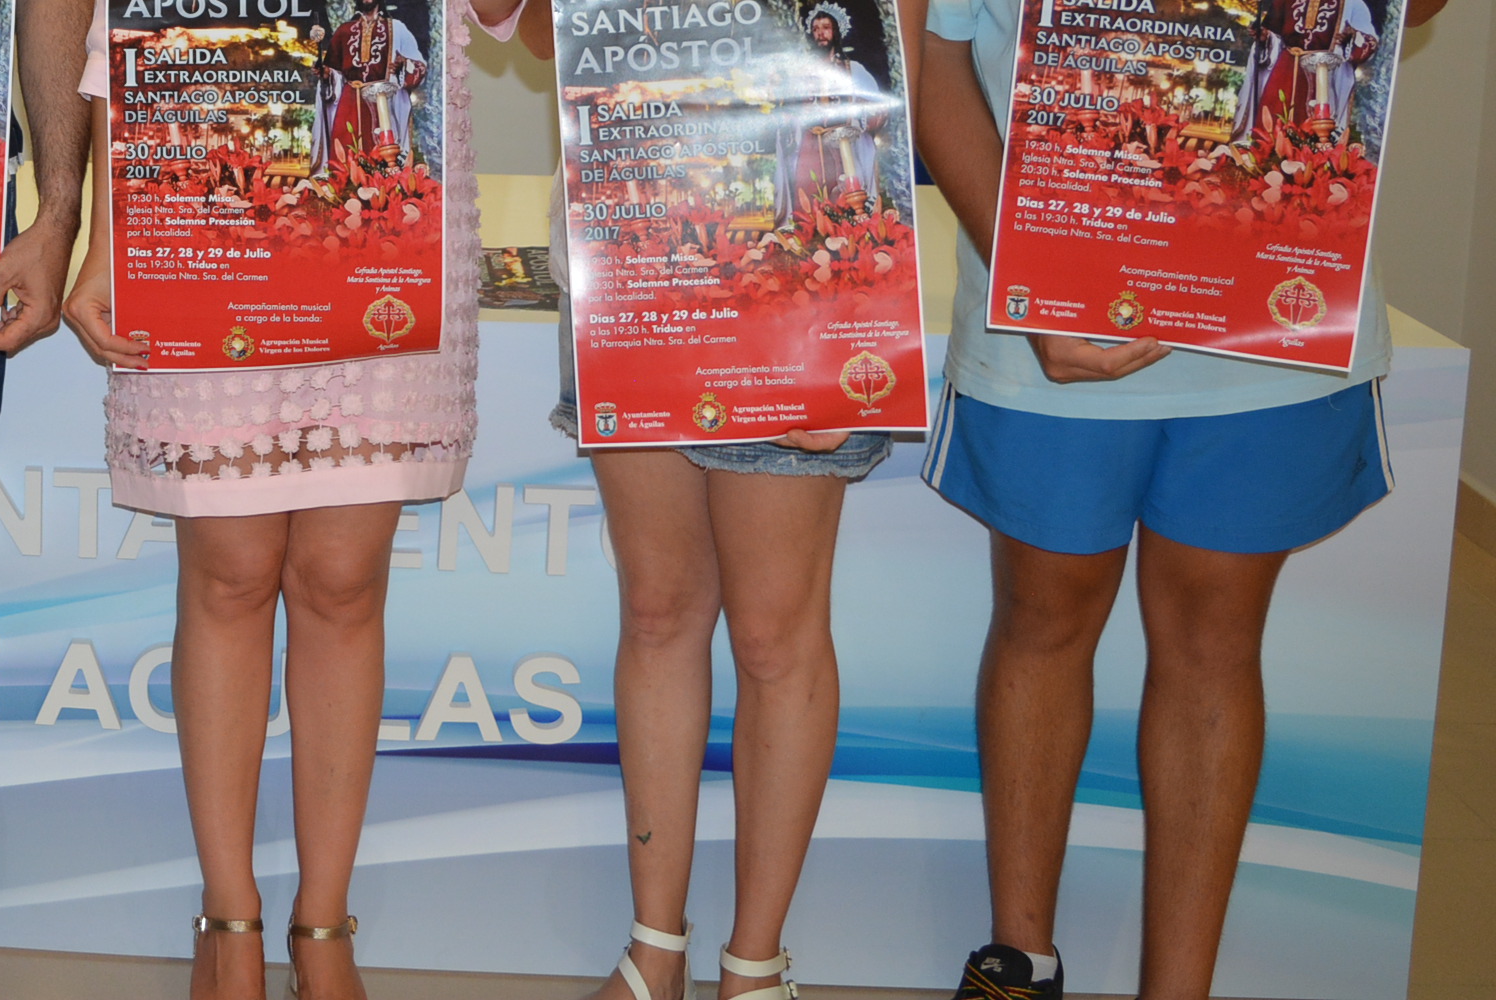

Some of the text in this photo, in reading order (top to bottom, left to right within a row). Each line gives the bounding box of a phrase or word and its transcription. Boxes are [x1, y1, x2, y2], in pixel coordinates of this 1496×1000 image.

[570, 0, 762, 36] SANTIAGO
[1060, 11, 1235, 42] EXTRAORDINARIA
[1036, 31, 1235, 64] SANTIAGO APÓSTOL
[144, 49, 227, 65] SALIDA
[1033, 51, 1147, 76] DE ÁGUILAS
[144, 70, 302, 83] EXTRAORDINARIA
[125, 87, 305, 103] SANTIAGO APÓSTOL
[1030, 87, 1119, 112] 30 JULIO
[125, 107, 227, 123] DE ÁGUILAS
[597, 101, 683, 122] SALIDA
[1026, 110, 1066, 127] 2017
[126, 144, 206, 159] 30 JULIO
[580, 138, 765, 163] SANTIAGO APÓSTOL
[126, 166, 160, 178] 2017
[581, 164, 686, 183] DE ÁGUILAS
[1019, 178, 1092, 192] por la localidad.
[127, 194, 234, 202] 19:30 h. Solemne Misa.
[584, 203, 666, 221] 30 JULIO
[1048, 200, 1069, 213] 27,
[1072, 203, 1090, 215] 28
[1093, 208, 1102, 217] y
[1105, 207, 1123, 218] 29
[1125, 208, 1142, 220] de
[1145, 210, 1177, 224] Julio
[585, 226, 620, 241] 2017
[156, 248, 174, 258] 27,
[178, 248, 193, 258] 28
[197, 251, 204, 259] y
[208, 248, 223, 258] 29
[226, 248, 240, 258] de
[244, 248, 271, 258] Julio
[619, 313, 638, 324] 27,
[642, 312, 657, 322] 28
[662, 314, 669, 323] y
[673, 310, 689, 321] 29
[692, 309, 706, 320] de
[710, 307, 738, 319] Julio
